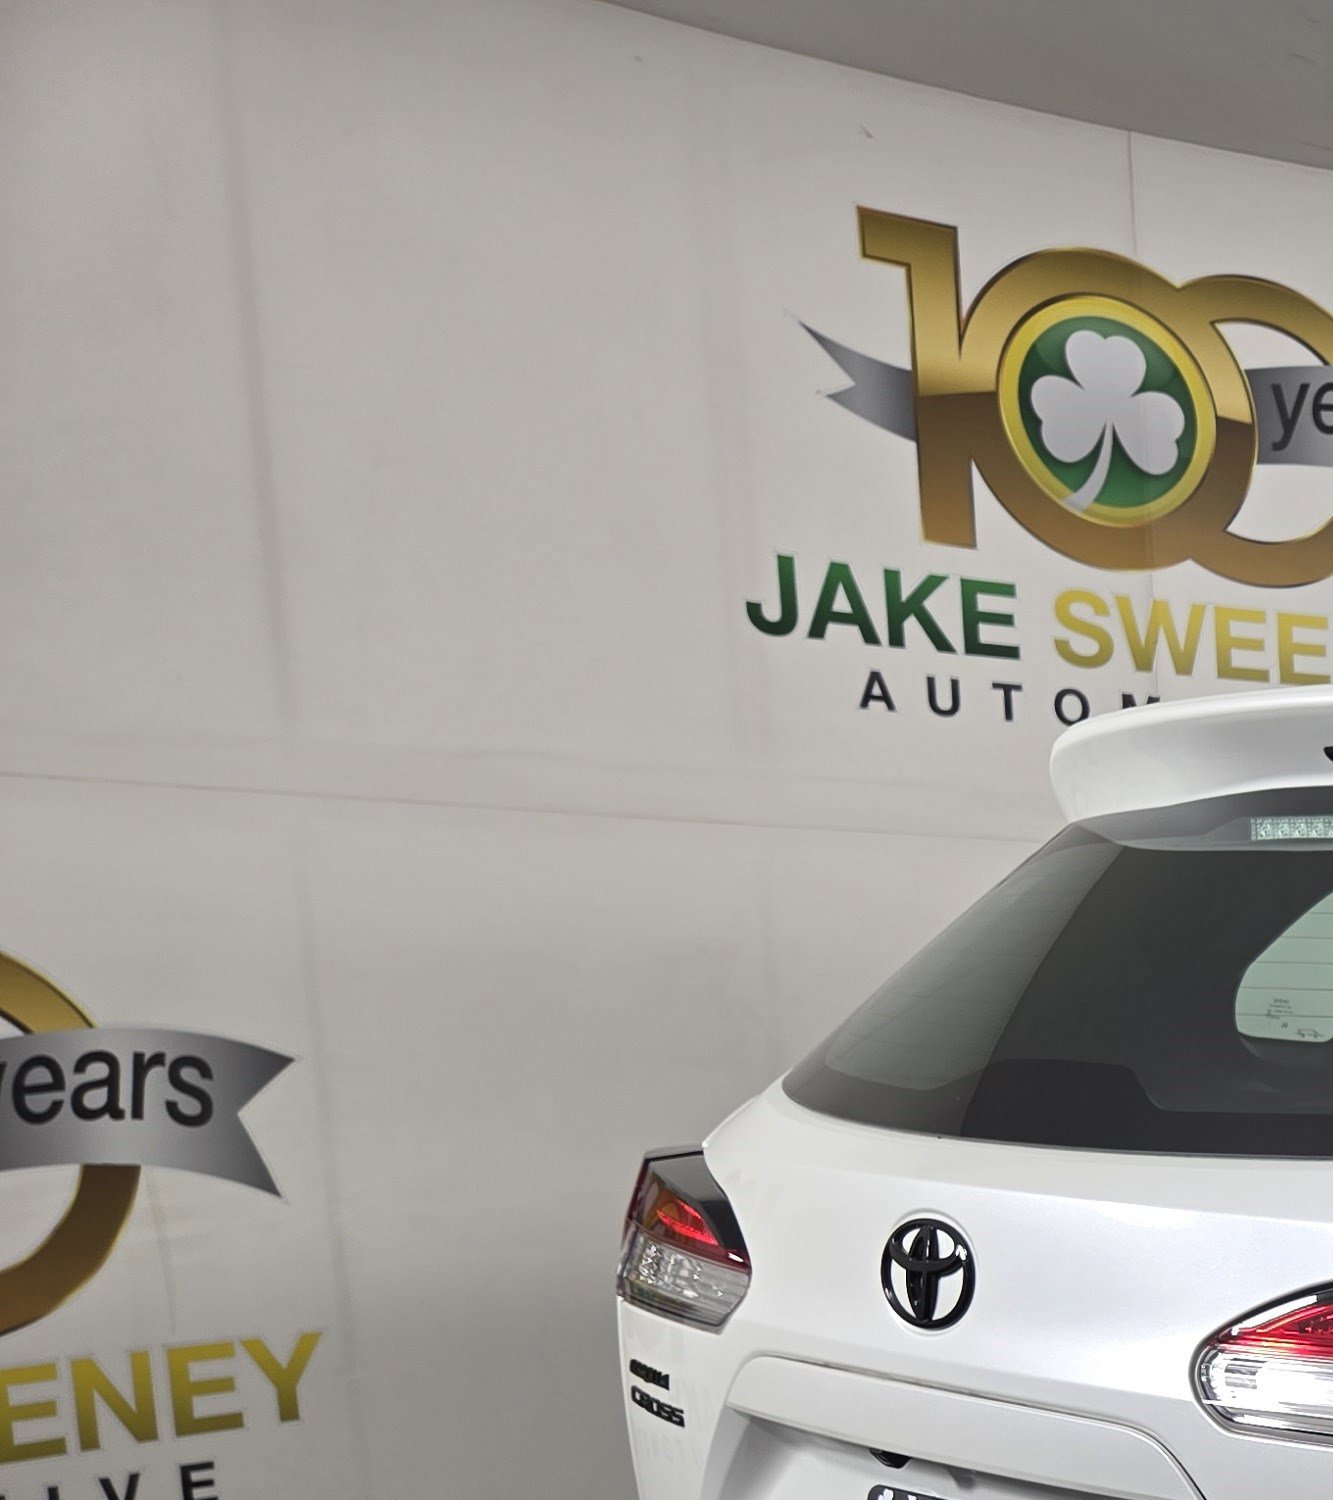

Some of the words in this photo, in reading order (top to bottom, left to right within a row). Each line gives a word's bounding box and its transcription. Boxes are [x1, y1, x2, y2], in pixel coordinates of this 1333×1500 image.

[745, 553, 1021, 661] JAKE
[858, 668, 1162, 727] AUTO
[0, 1049, 215, 1129] ears
